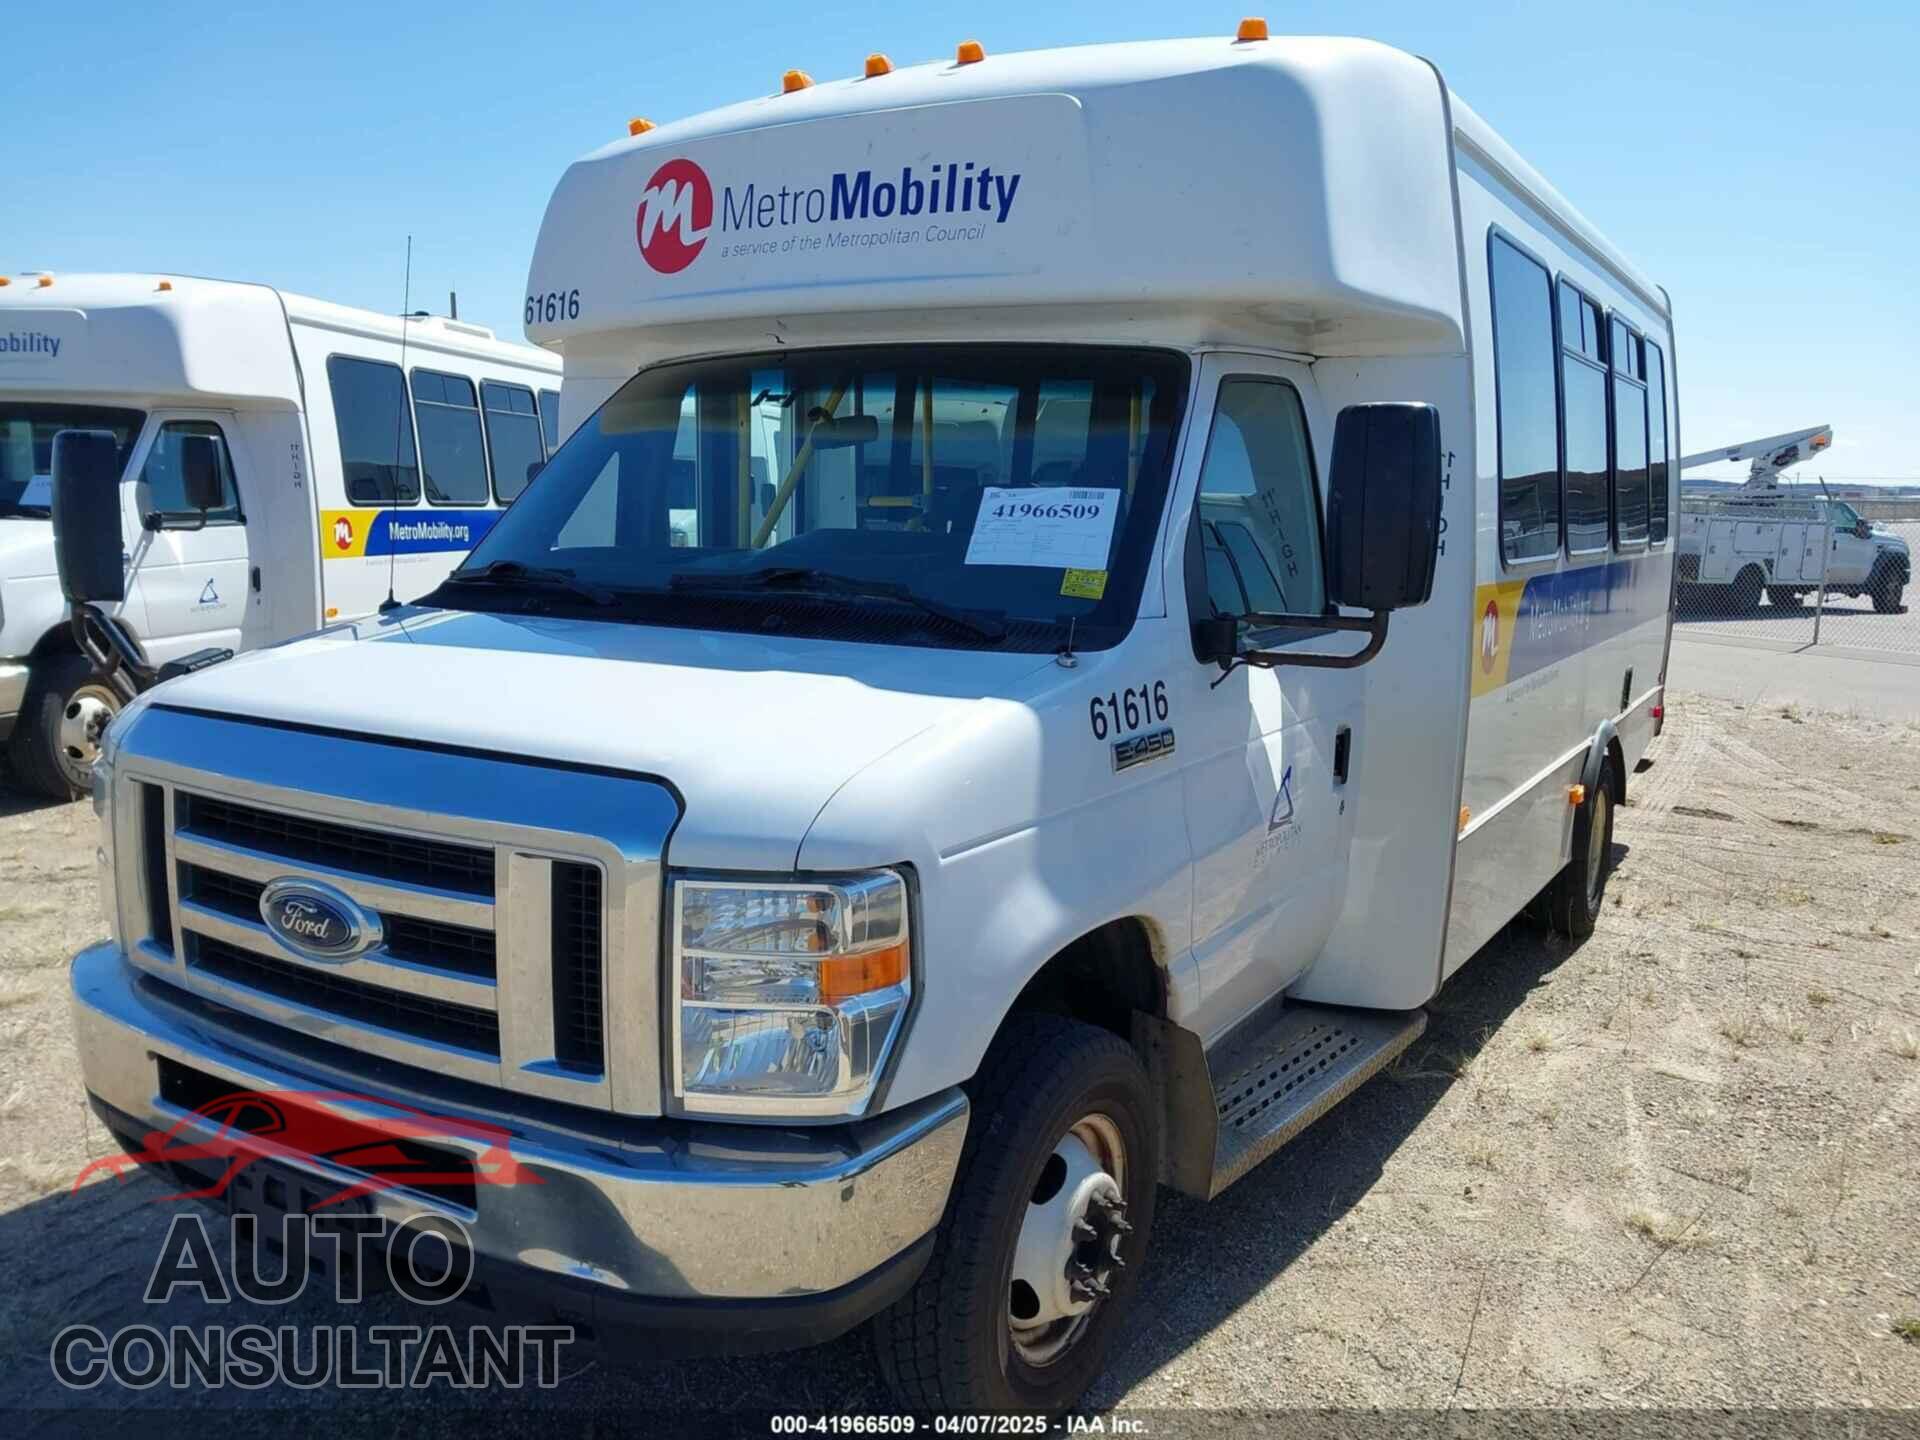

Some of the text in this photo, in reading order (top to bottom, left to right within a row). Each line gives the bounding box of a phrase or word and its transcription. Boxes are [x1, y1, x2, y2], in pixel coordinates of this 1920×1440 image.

[721, 162, 1021, 232] MetroMobility
[721, 223, 986, 258] a service of the Metropolitan Council
[525, 289, 580, 325] 61616
[992, 503, 1100, 519] 41966509
[388, 521, 469, 542] MetroMobility.org
[1090, 680, 1168, 740] 61616
[281, 901, 330, 938] Ford
